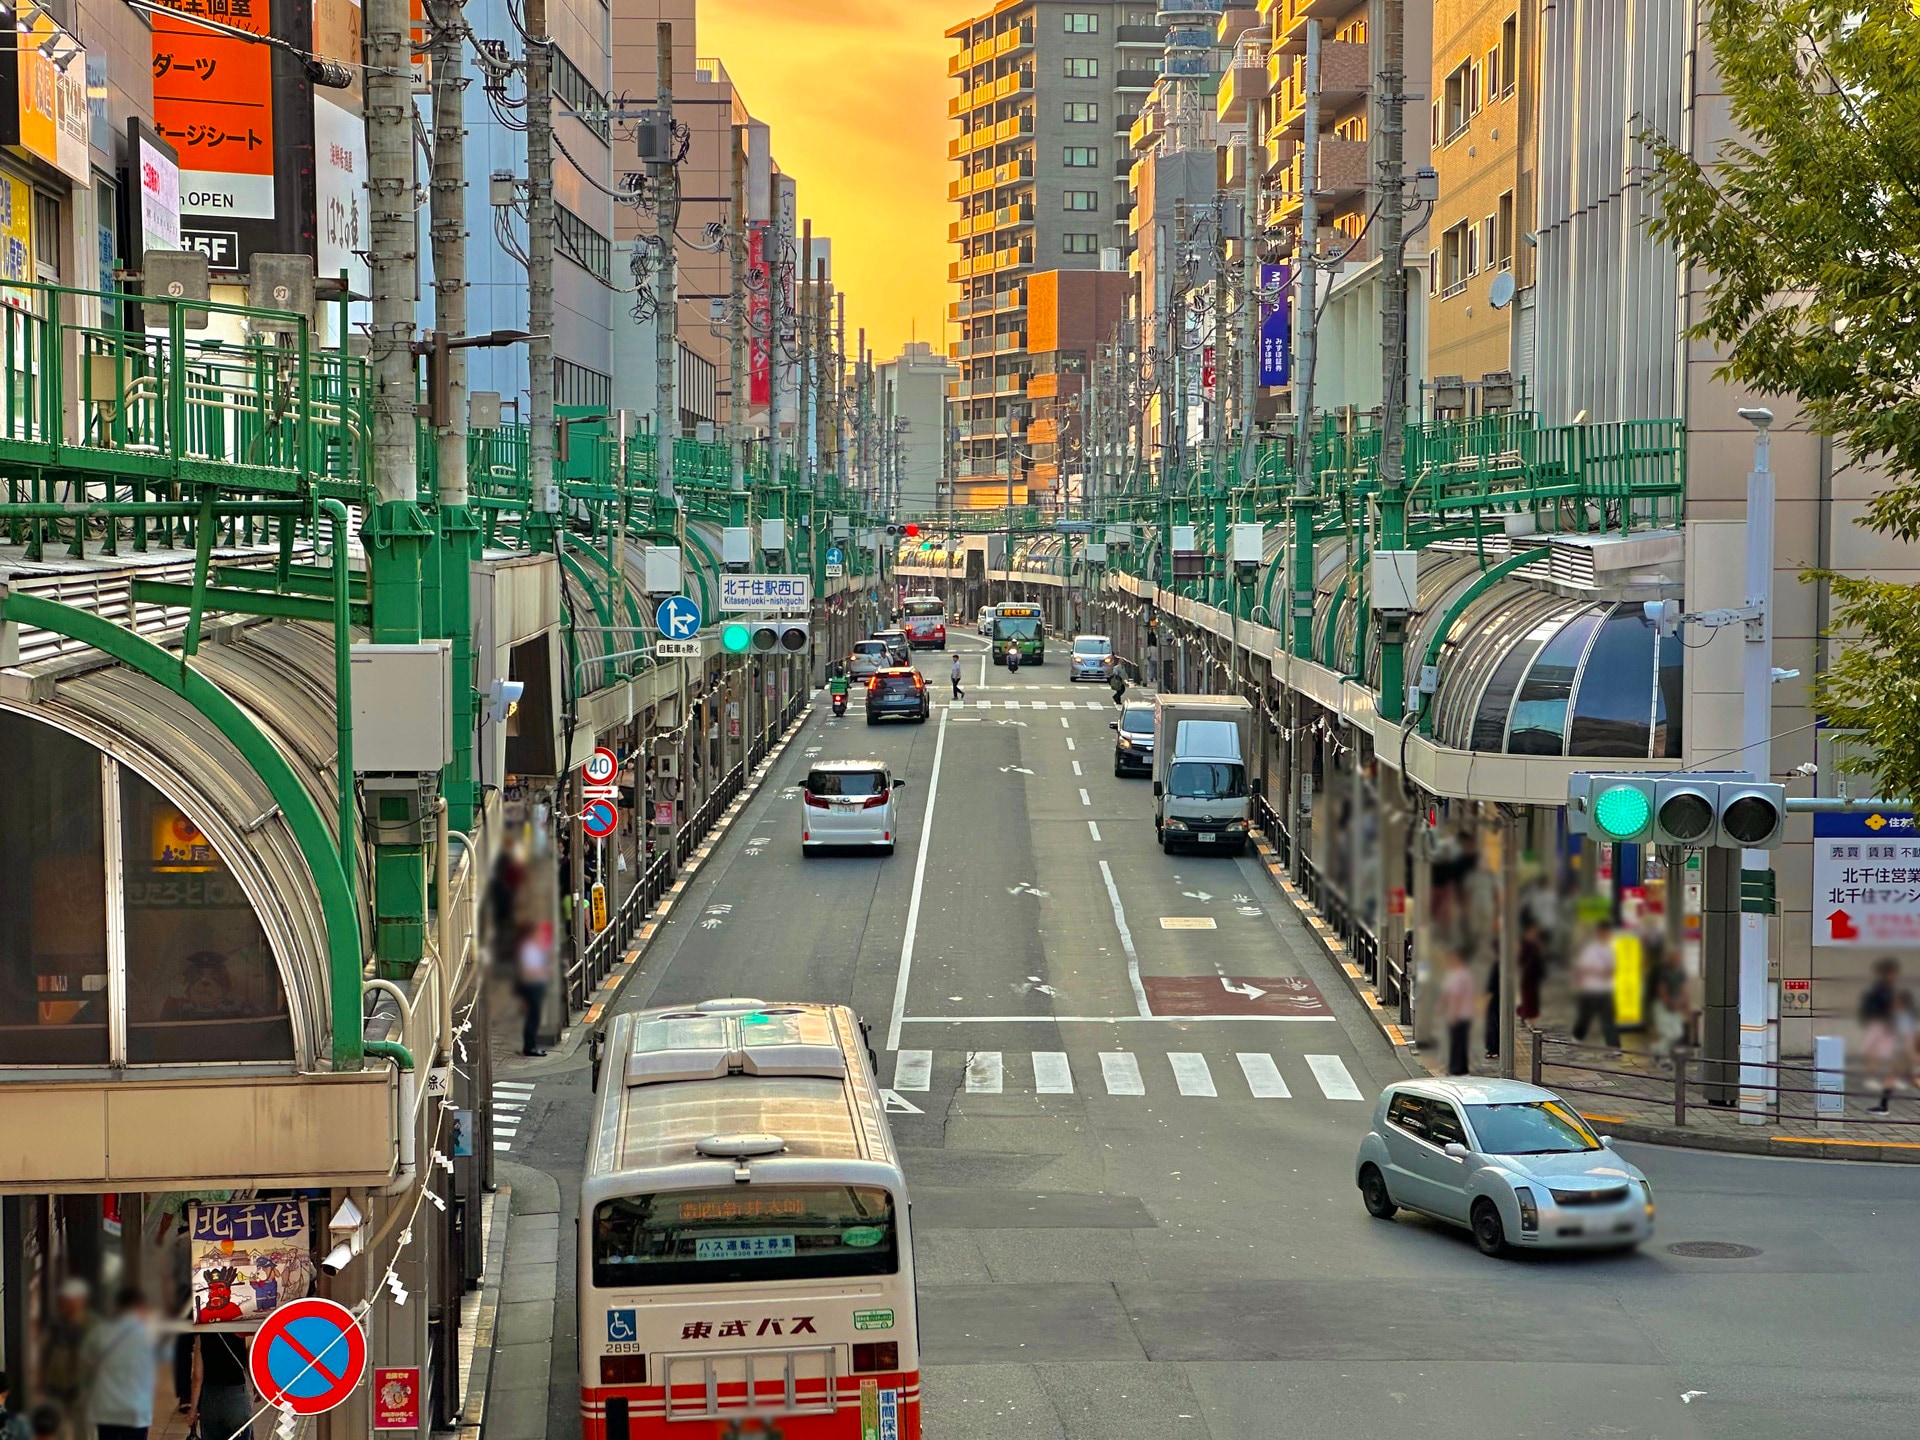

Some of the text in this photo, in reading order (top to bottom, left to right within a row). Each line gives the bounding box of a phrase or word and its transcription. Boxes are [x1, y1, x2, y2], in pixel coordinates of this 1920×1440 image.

[152, 53, 216, 81] ダーツ
[188, 192, 234, 208] OPEN
[171, 283, 182, 295] 力
[275, 287, 287, 299] 灯
[1264, 338, 1272, 372] みずほ銀行
[1275, 338, 1283, 372] みずほ証券
[723, 580, 805, 596] 北千住駅西口
[658, 644, 699, 654] 自転車を除く
[588, 758, 609, 775] 40
[1832, 846, 1859, 858] 売買
[1868, 846, 1894, 858] 賃貸
[1842, 867, 1920, 884] 北千住営業
[198, 1203, 301, 1237] 北千住
[699, 1238, 792, 1251] バス運転士募集
[681, 1316, 817, 1339] 東武バス
[605, 1343, 640, 1353] 2899
